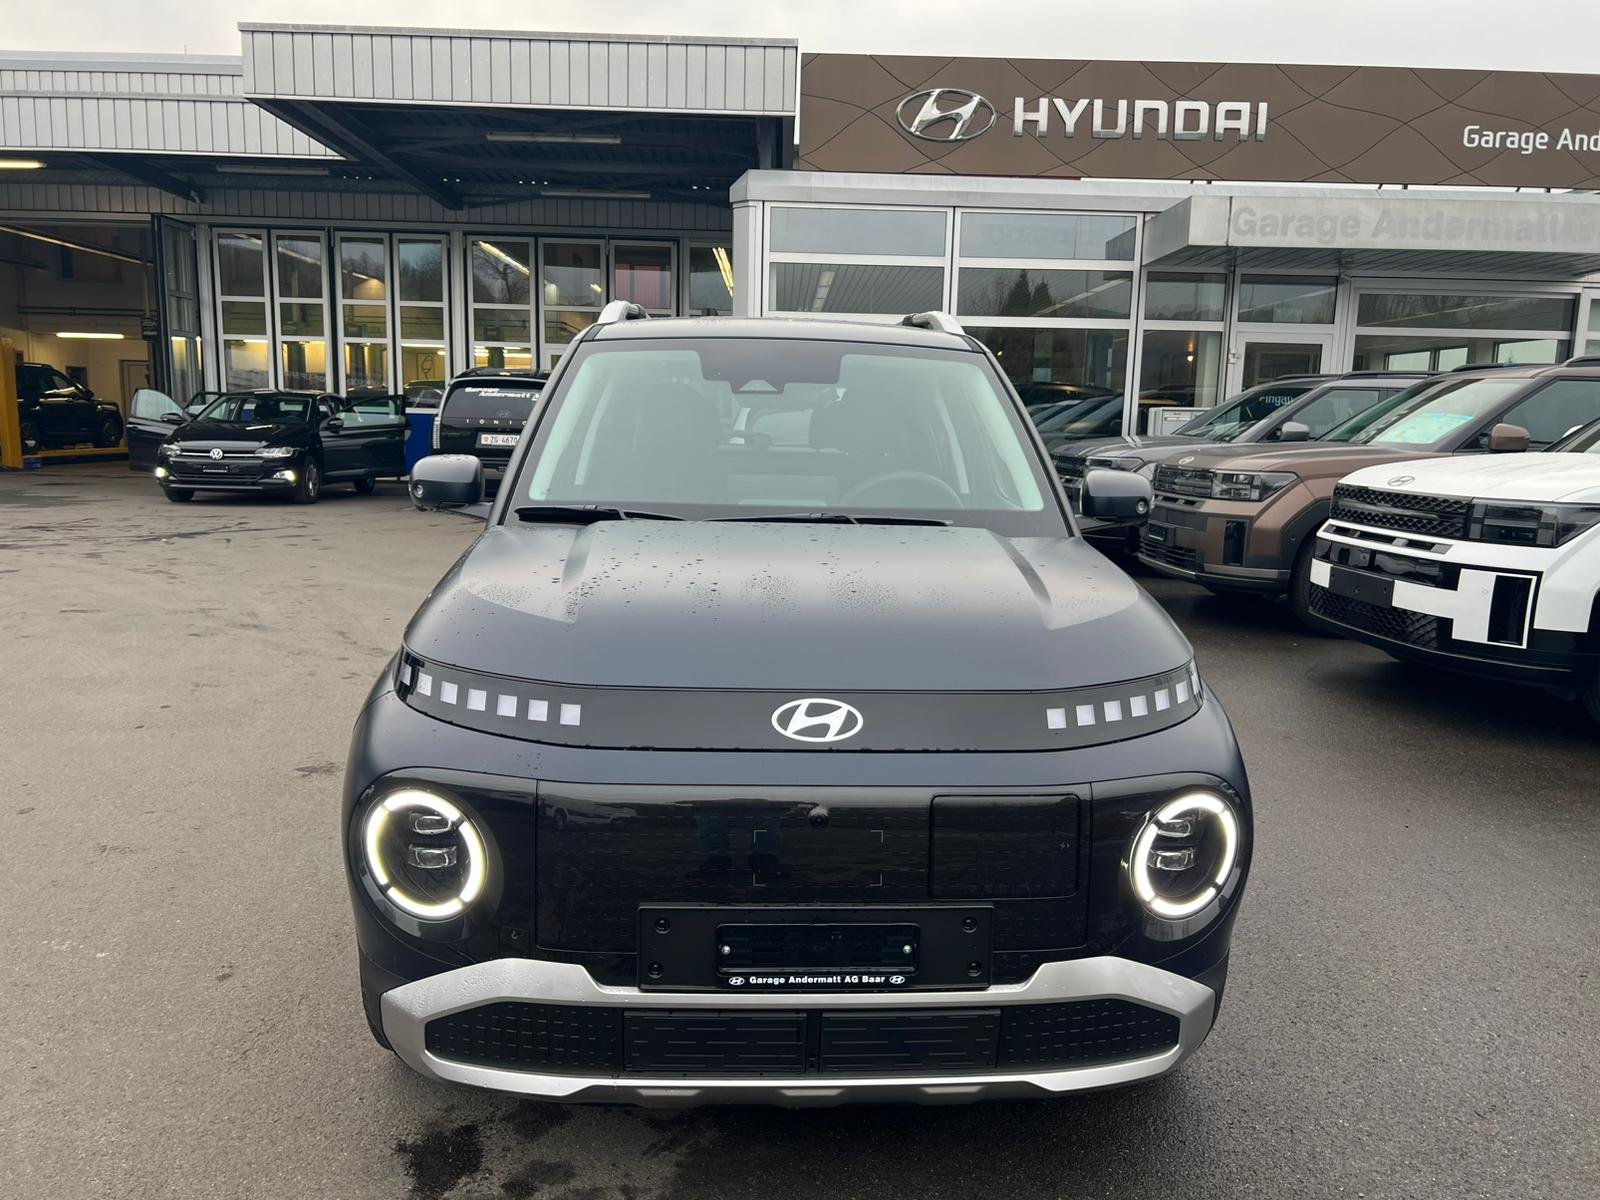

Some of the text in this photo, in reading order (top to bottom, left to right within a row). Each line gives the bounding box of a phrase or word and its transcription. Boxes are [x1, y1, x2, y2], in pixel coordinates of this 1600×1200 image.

[1012, 96, 1269, 142] HYUNDAI
[1462, 124, 1549, 155] Garage
[1231, 205, 1362, 244] Garage
[749, 975, 886, 985] Garage Andermatt AG Baar
